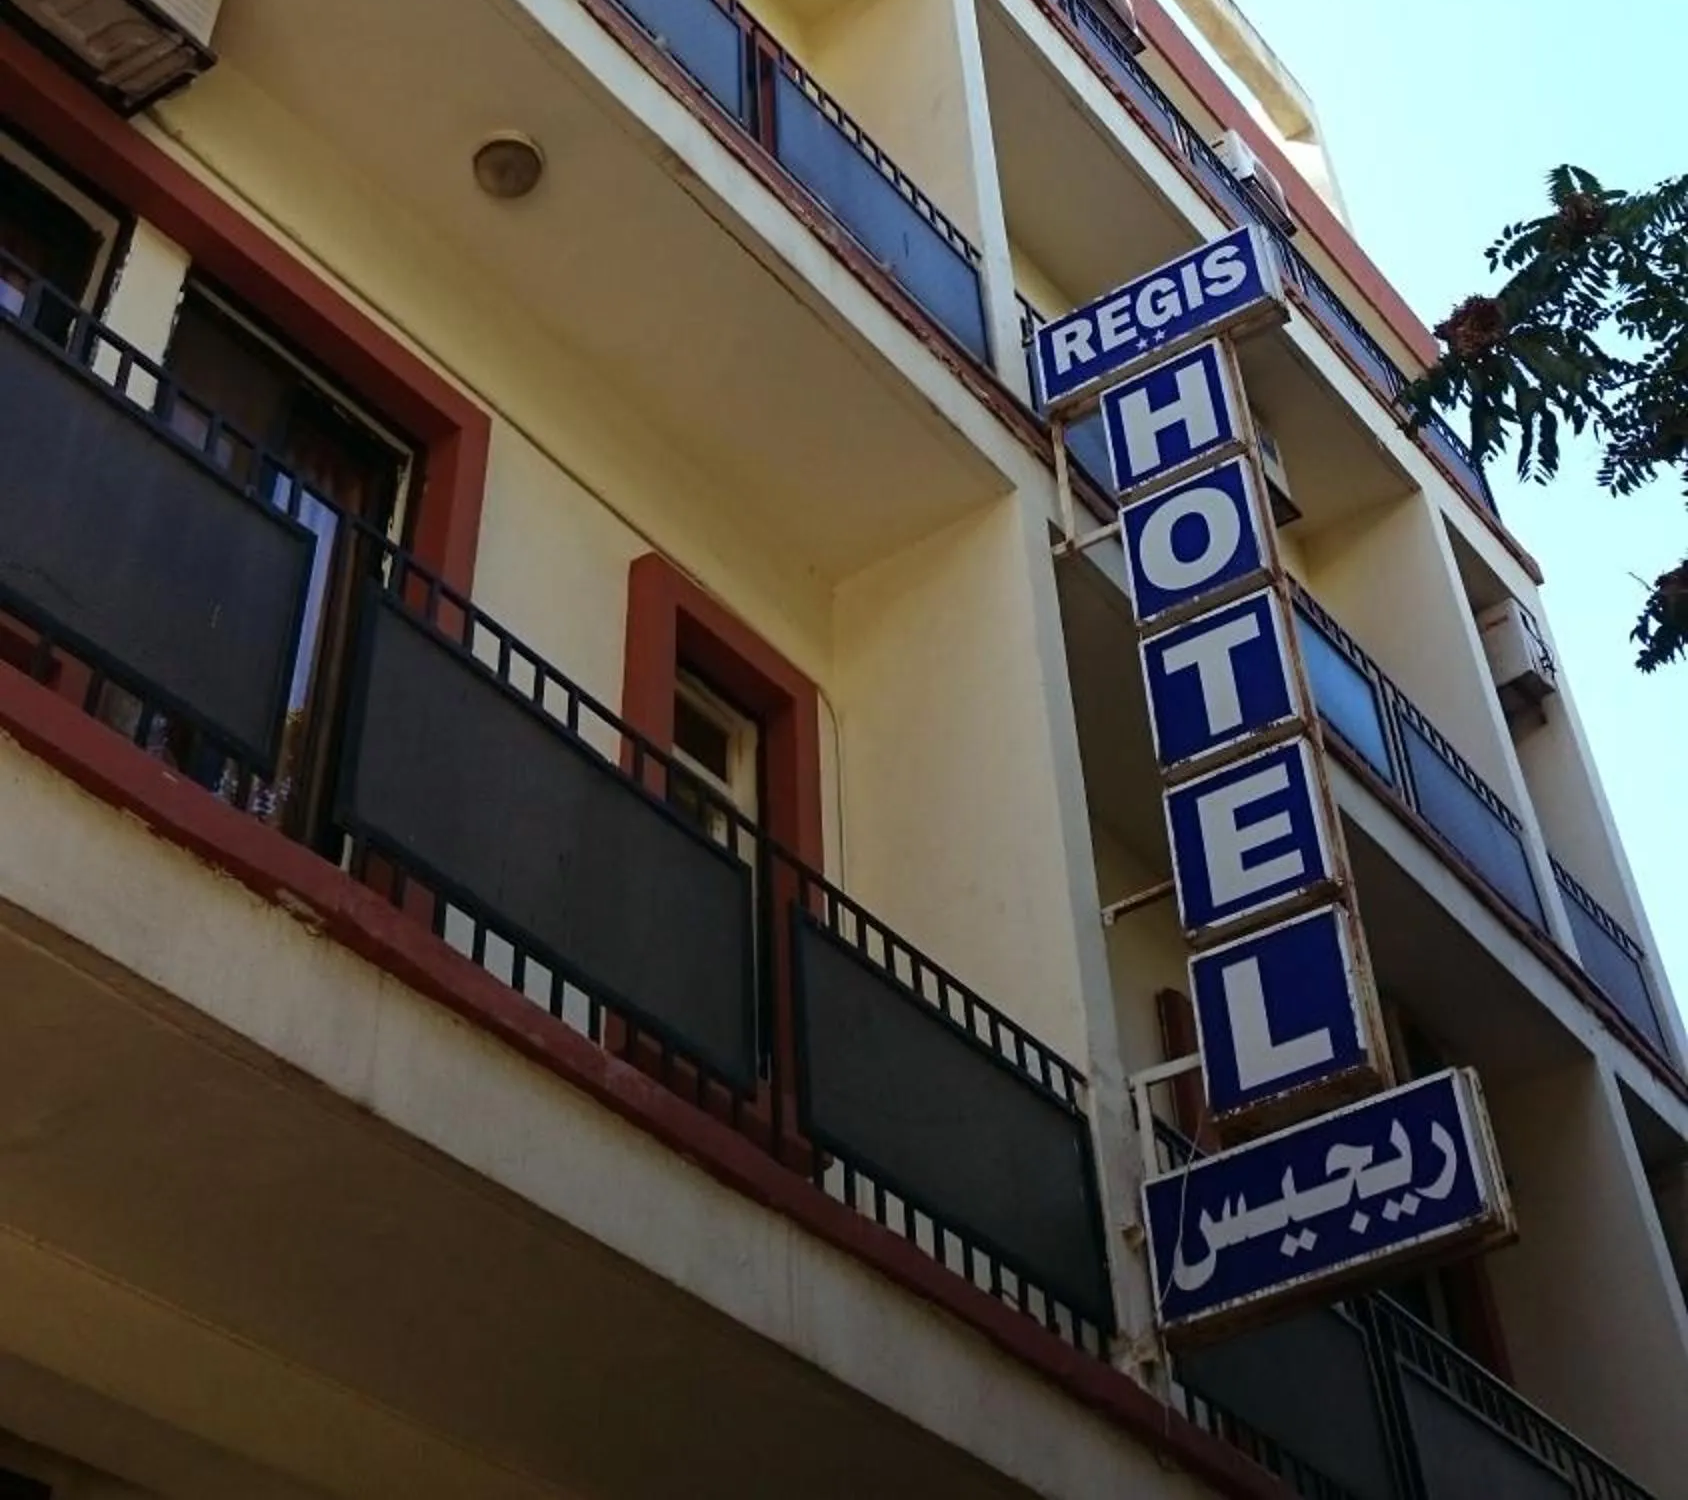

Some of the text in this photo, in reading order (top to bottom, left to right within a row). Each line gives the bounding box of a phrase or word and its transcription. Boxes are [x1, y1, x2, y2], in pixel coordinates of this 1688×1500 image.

[1051, 244, 1247, 376] REGIS
[1118, 361, 1334, 1091] HOTEL
[1173, 1117, 1458, 1291] ريجيس
